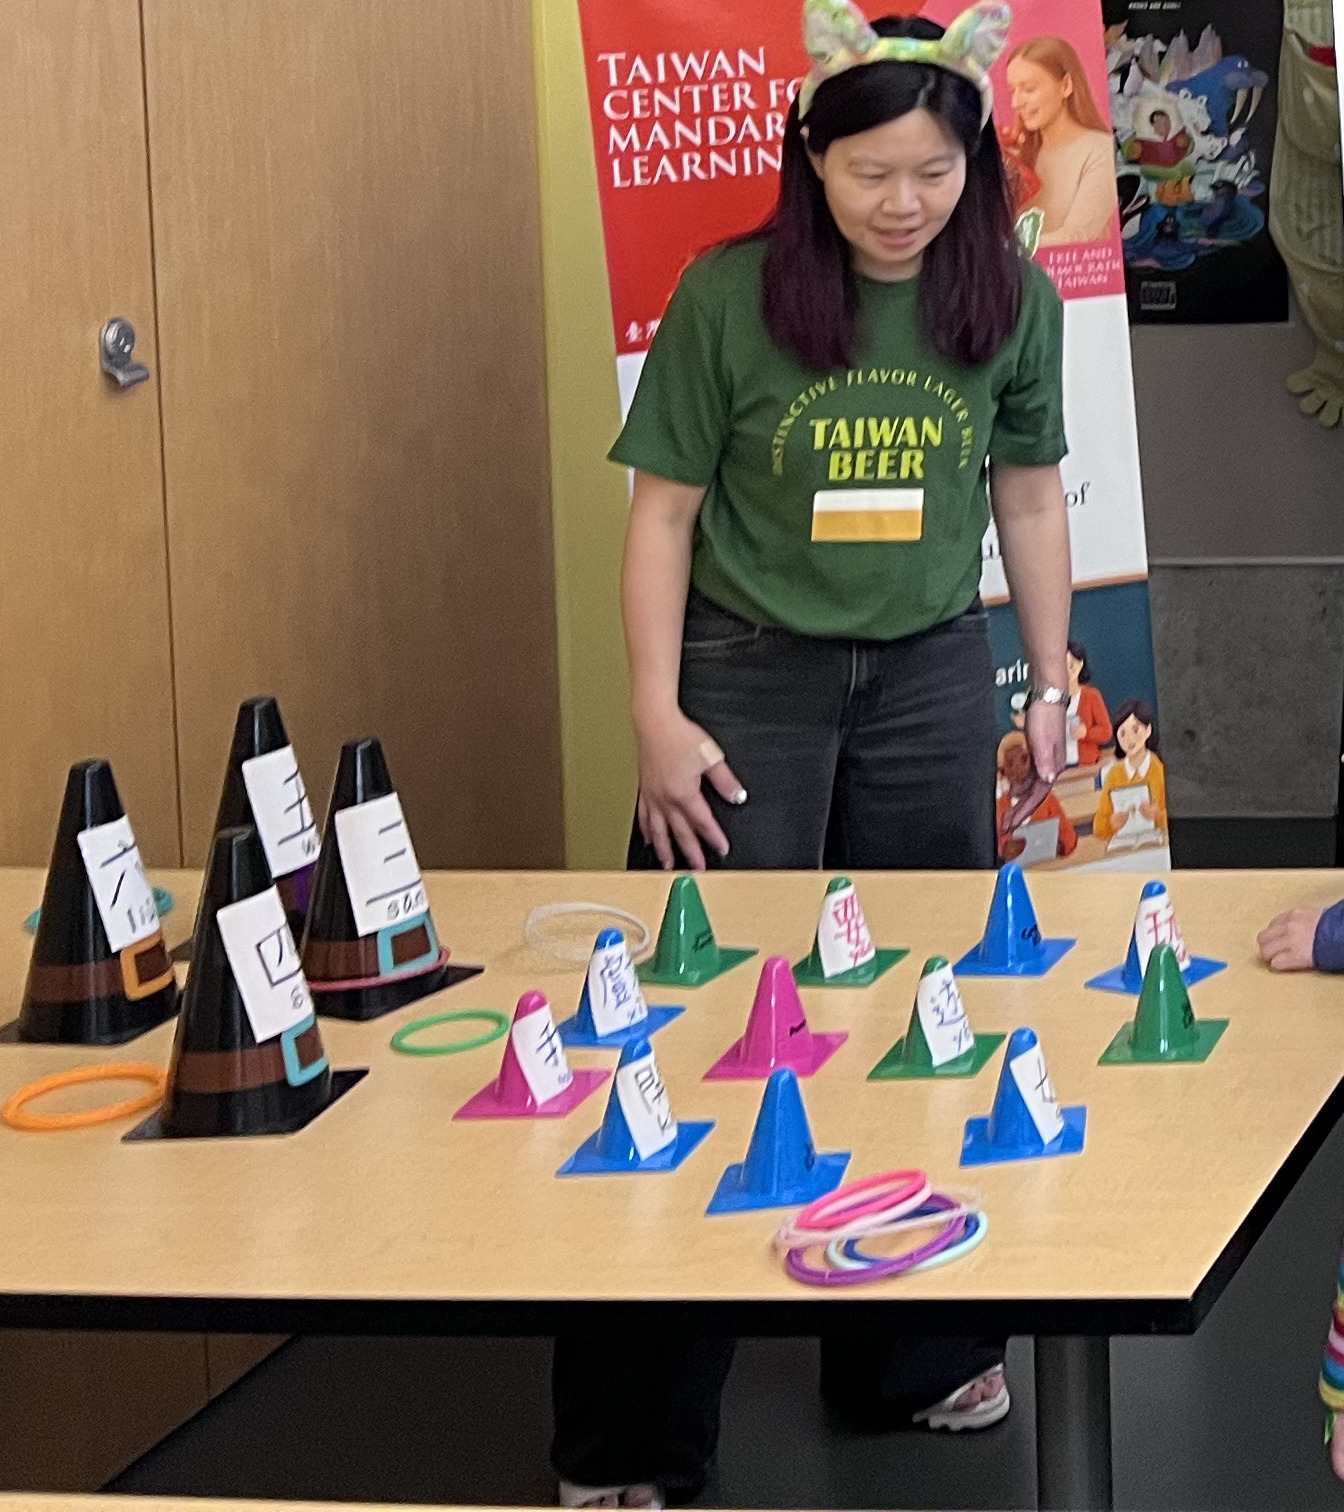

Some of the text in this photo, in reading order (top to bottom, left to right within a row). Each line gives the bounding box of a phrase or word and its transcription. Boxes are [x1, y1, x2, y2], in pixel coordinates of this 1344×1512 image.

[597, 46, 765, 87] TAIWAN
[603, 80, 758, 120] CENTER
[608, 111, 786, 155] MANDAR
[612, 144, 783, 189] LEARNIN
[847, 368, 918, 388] FLAVOR
[809, 415, 943, 451] TAIWAN
[828, 449, 925, 482] BEER
